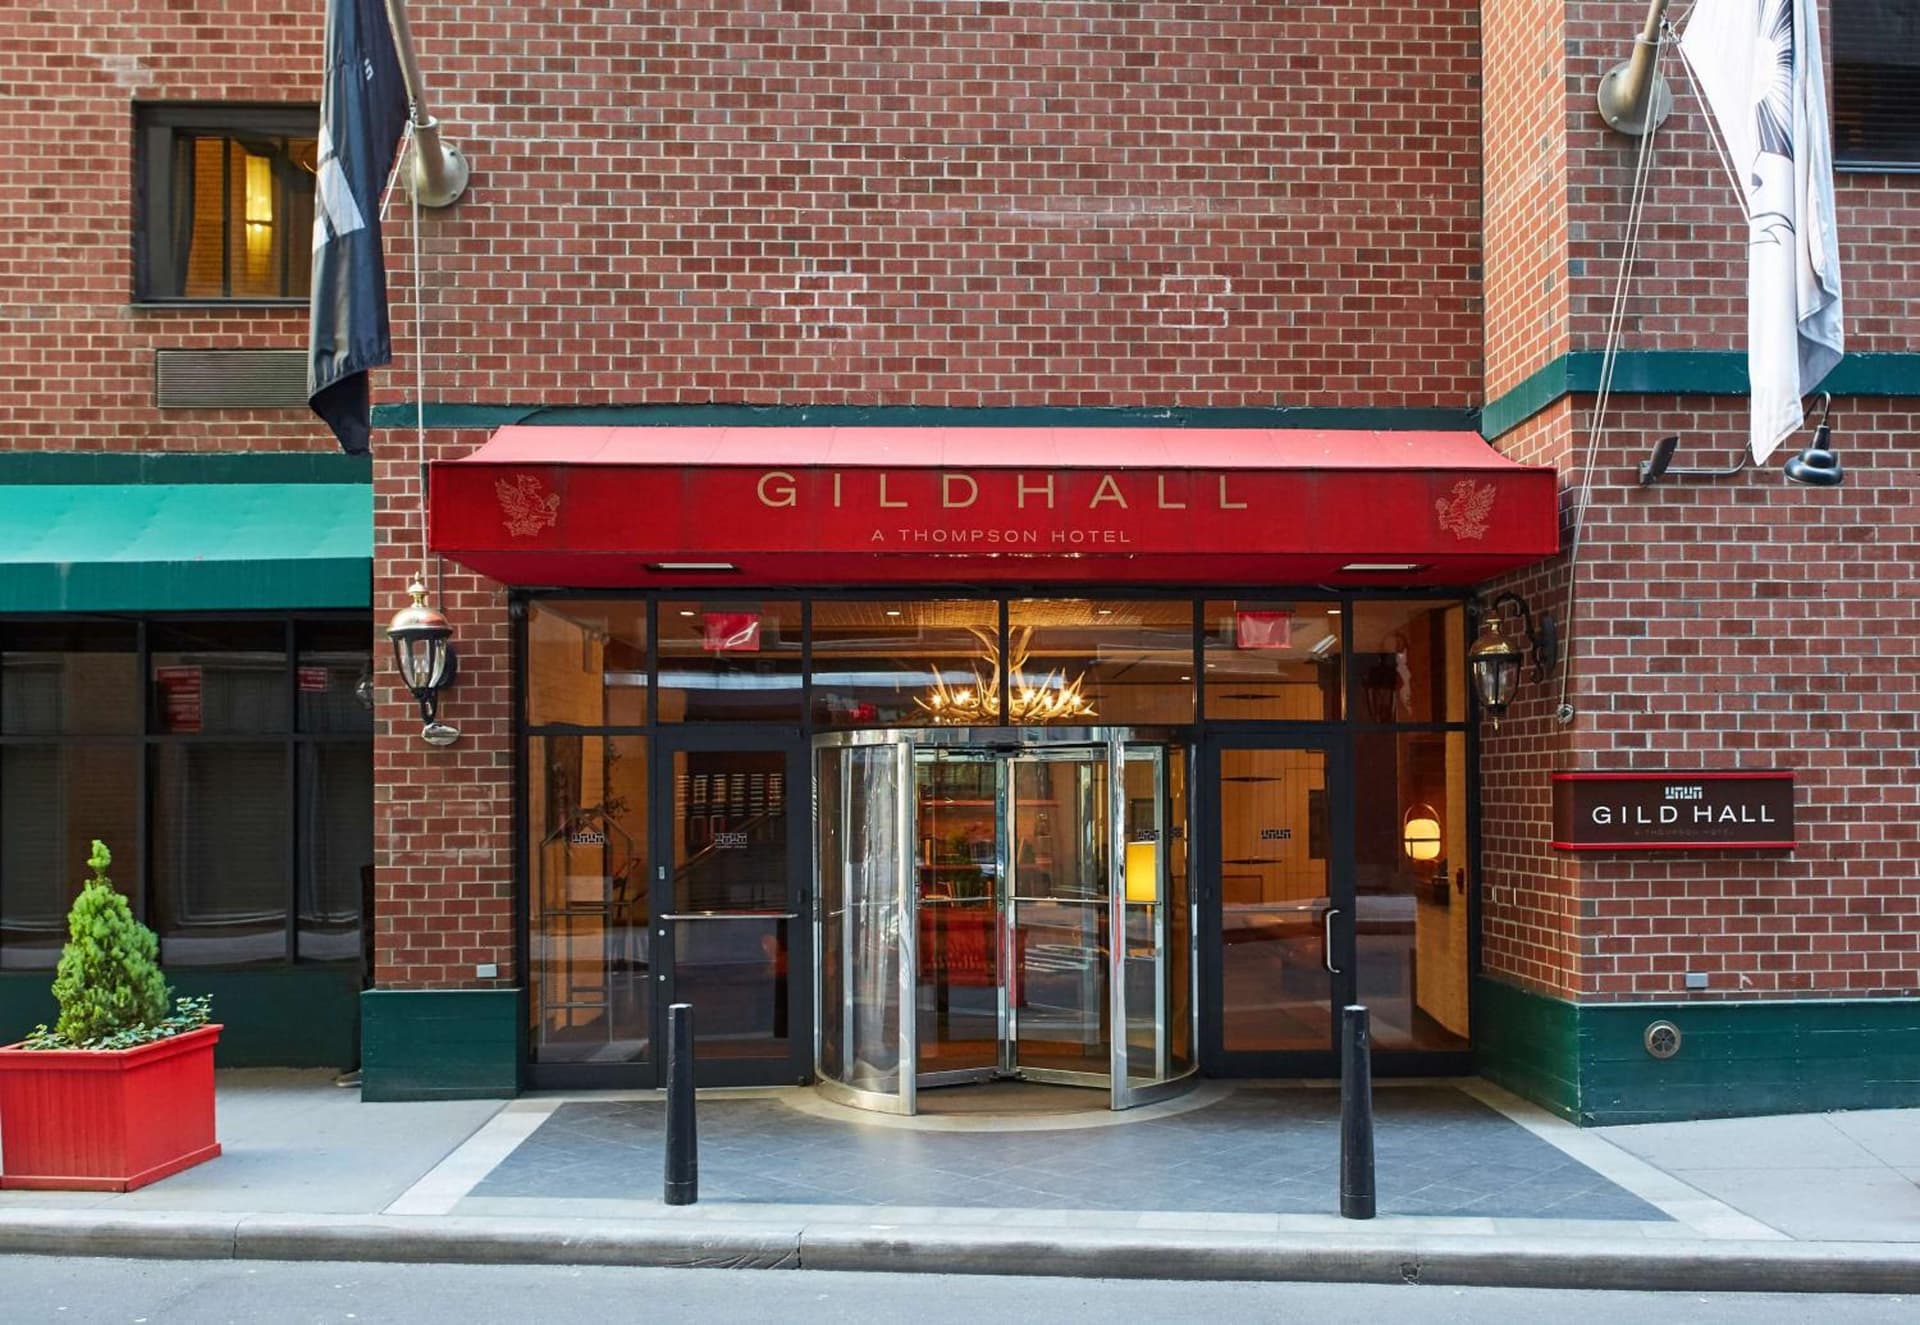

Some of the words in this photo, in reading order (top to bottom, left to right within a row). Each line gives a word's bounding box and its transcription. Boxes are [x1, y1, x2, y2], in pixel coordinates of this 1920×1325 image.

[871, 529, 885, 543] A
[898, 528, 1037, 544] THOMPSON
[1051, 530, 1130, 544] HOTEL
[1591, 804, 1679, 825] GILD
[1693, 804, 1776, 824] HALL
